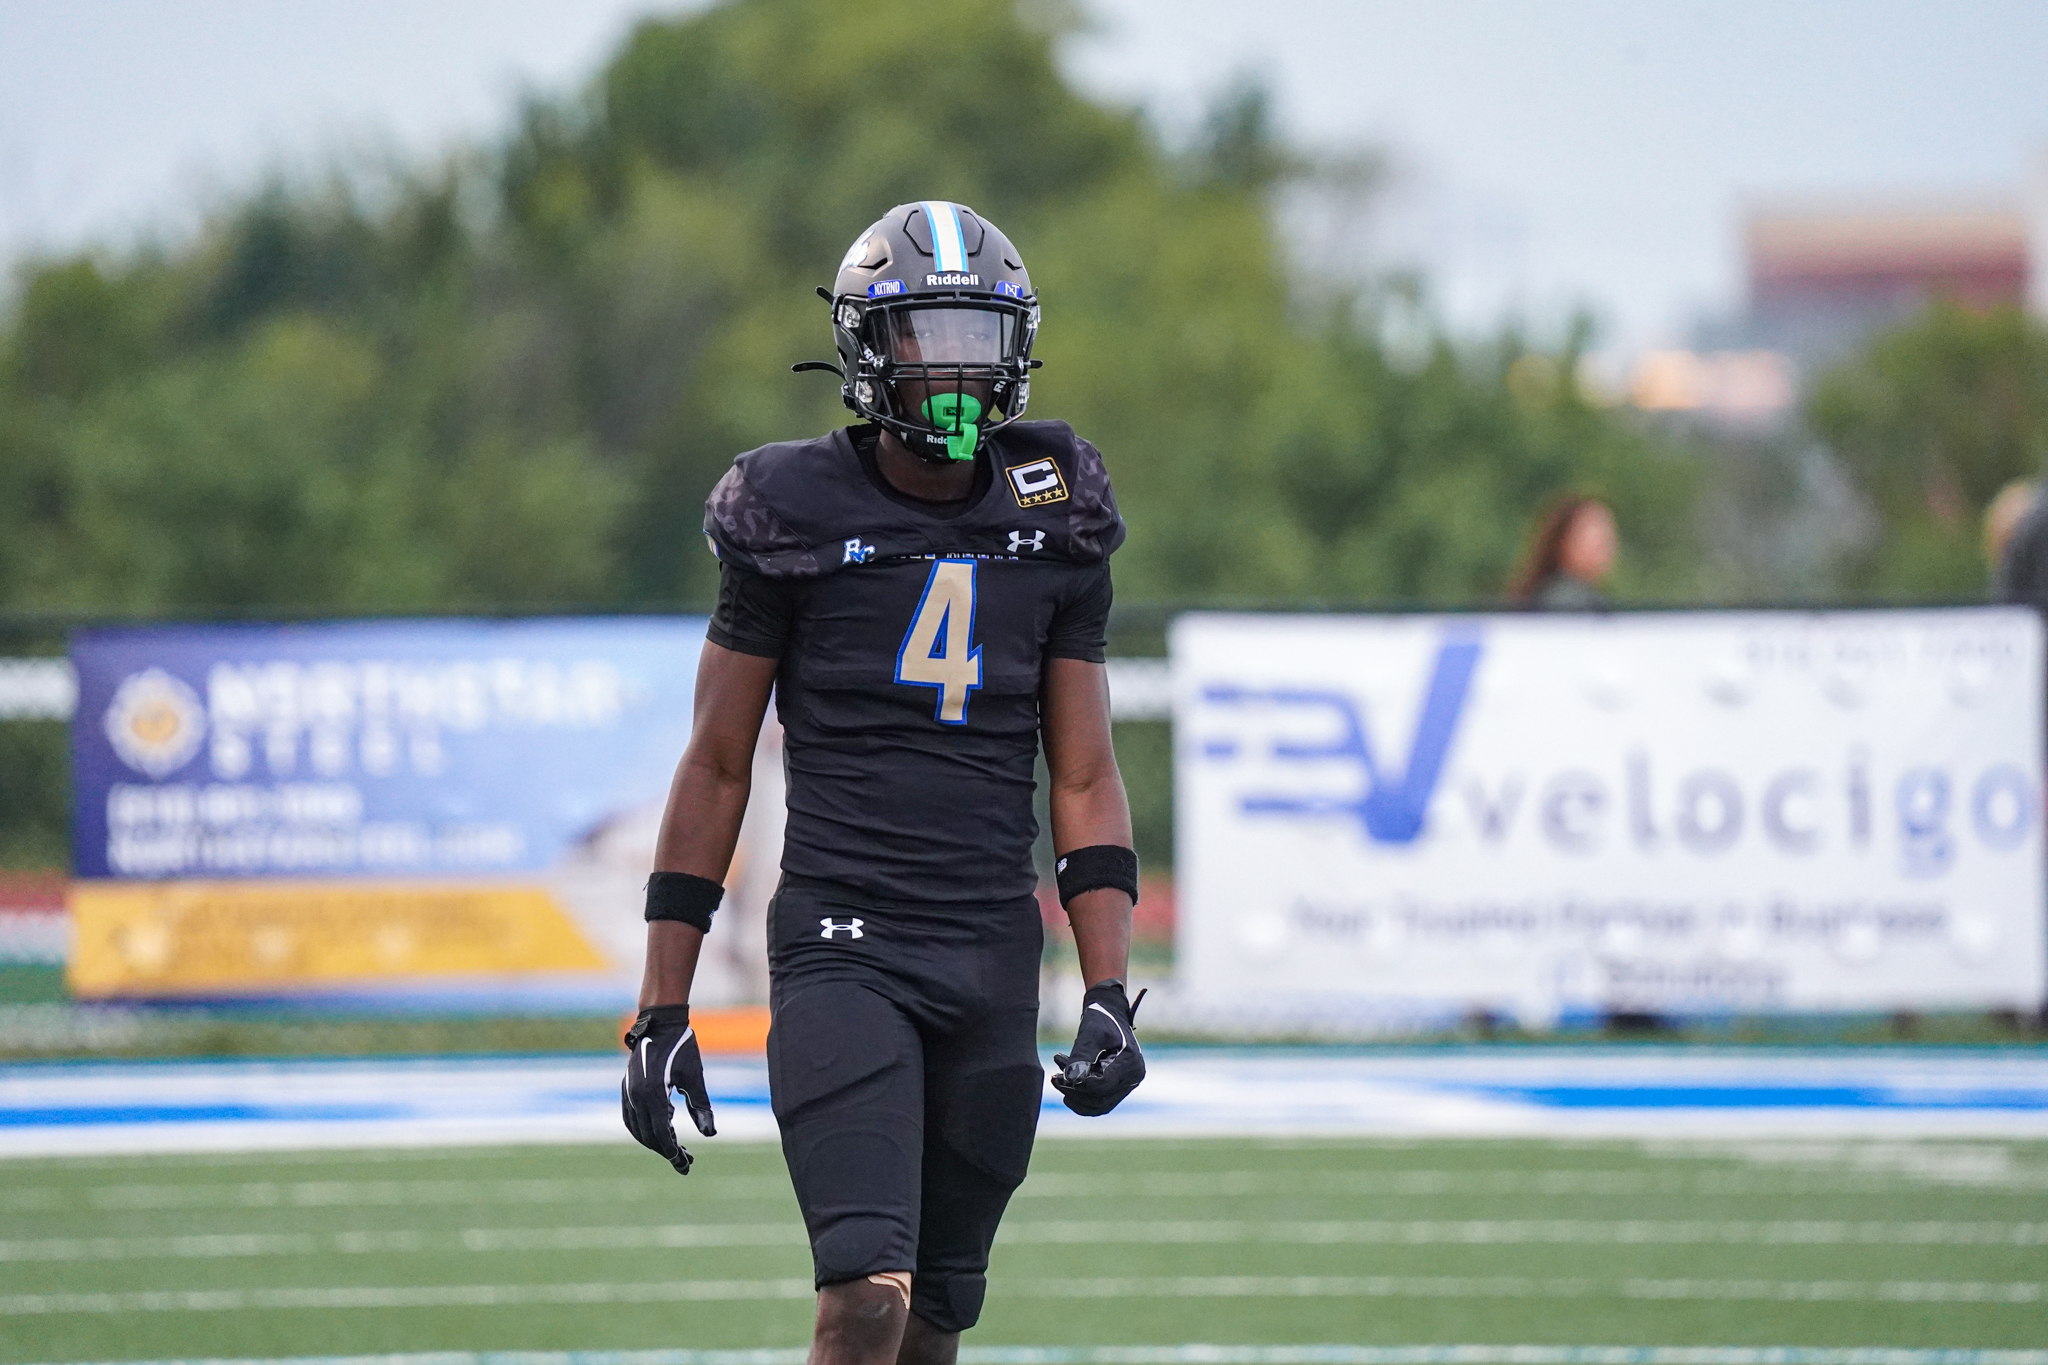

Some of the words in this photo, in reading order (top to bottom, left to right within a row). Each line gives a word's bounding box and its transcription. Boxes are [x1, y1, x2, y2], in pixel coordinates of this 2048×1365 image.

[873, 281, 901, 296] NXTRND
[926, 274, 979, 286] Riddell
[1010, 459, 1058, 495] C
[894, 558, 983, 725] 4
[1466, 738, 2034, 878] velocigo
